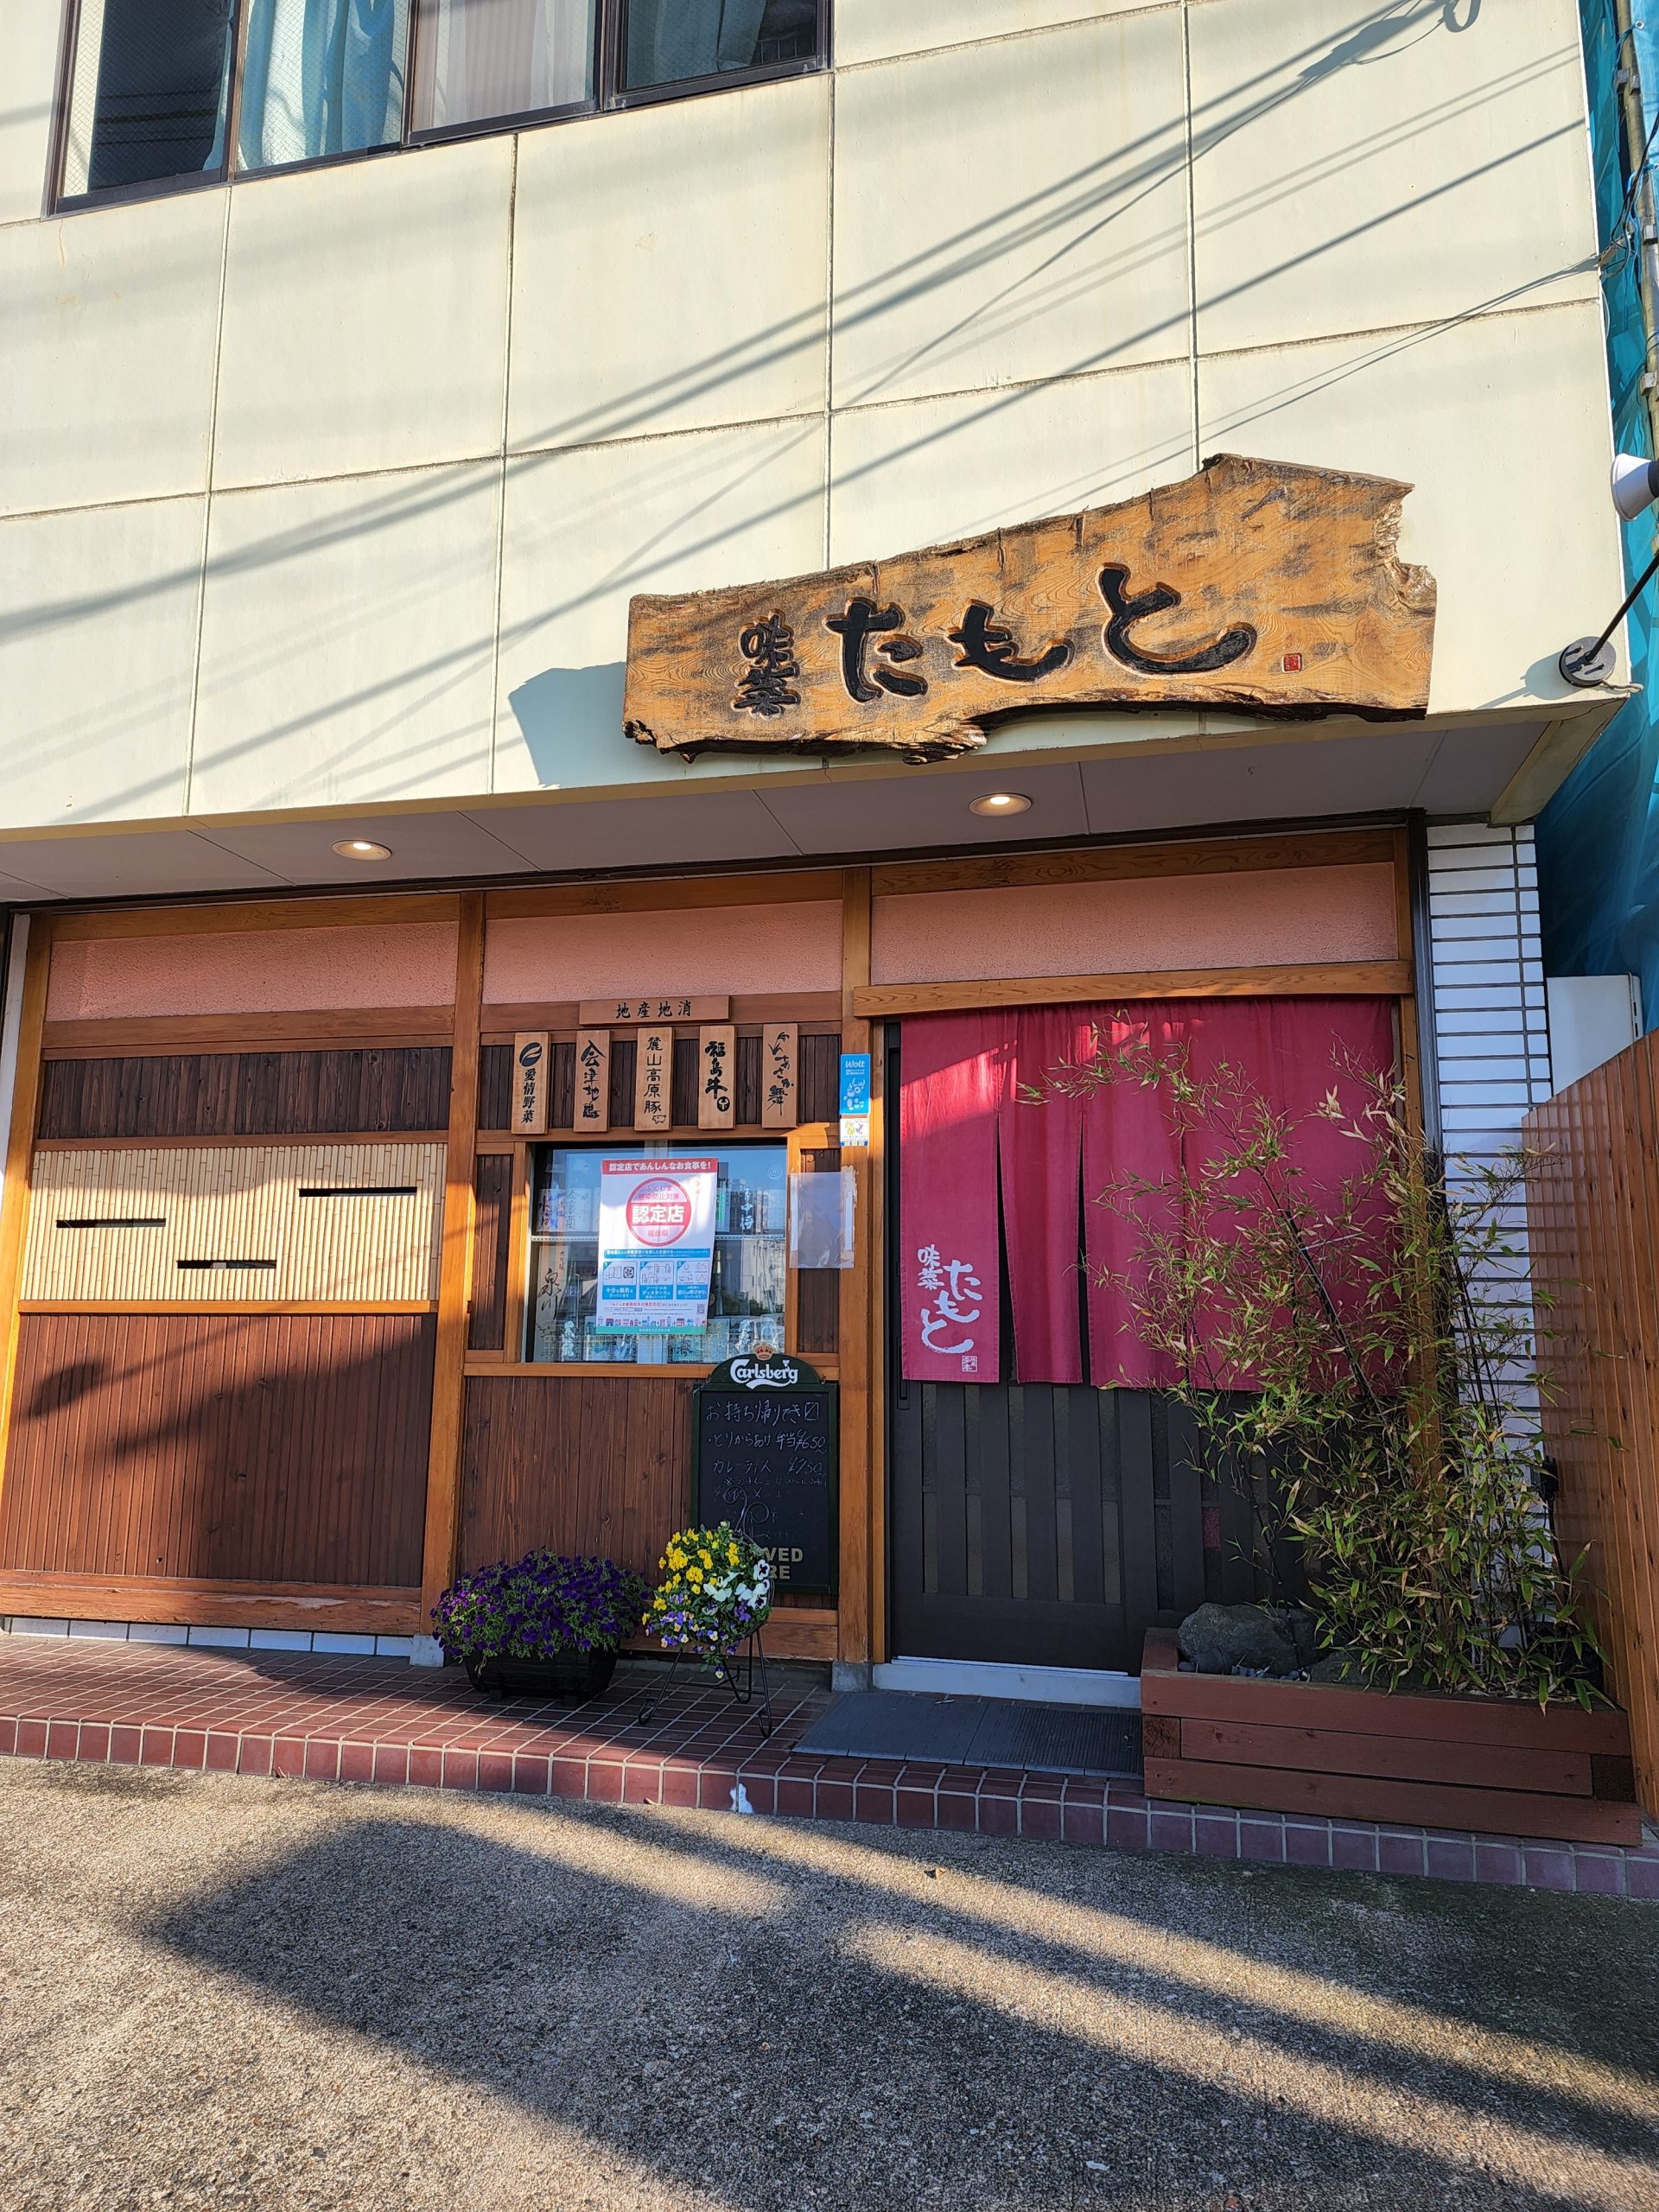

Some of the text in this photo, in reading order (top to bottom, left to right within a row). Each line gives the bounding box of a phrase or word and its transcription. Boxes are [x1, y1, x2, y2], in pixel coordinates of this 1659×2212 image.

[826, 562, 1256, 702] たもと
[616, 1000, 692, 1020] 地産地消
[643, 1036, 664, 1115] 麓山高原豚
[704, 1040, 728, 1100] 福島牛
[845, 1059, 866, 1068] Wolt
[521, 1067, 537, 1124] 愛情野菜
[632, 1204, 685, 1224] 認定店
[920, 1259, 983, 1355] たもと
[730, 1359, 799, 1385] Carlsberg
